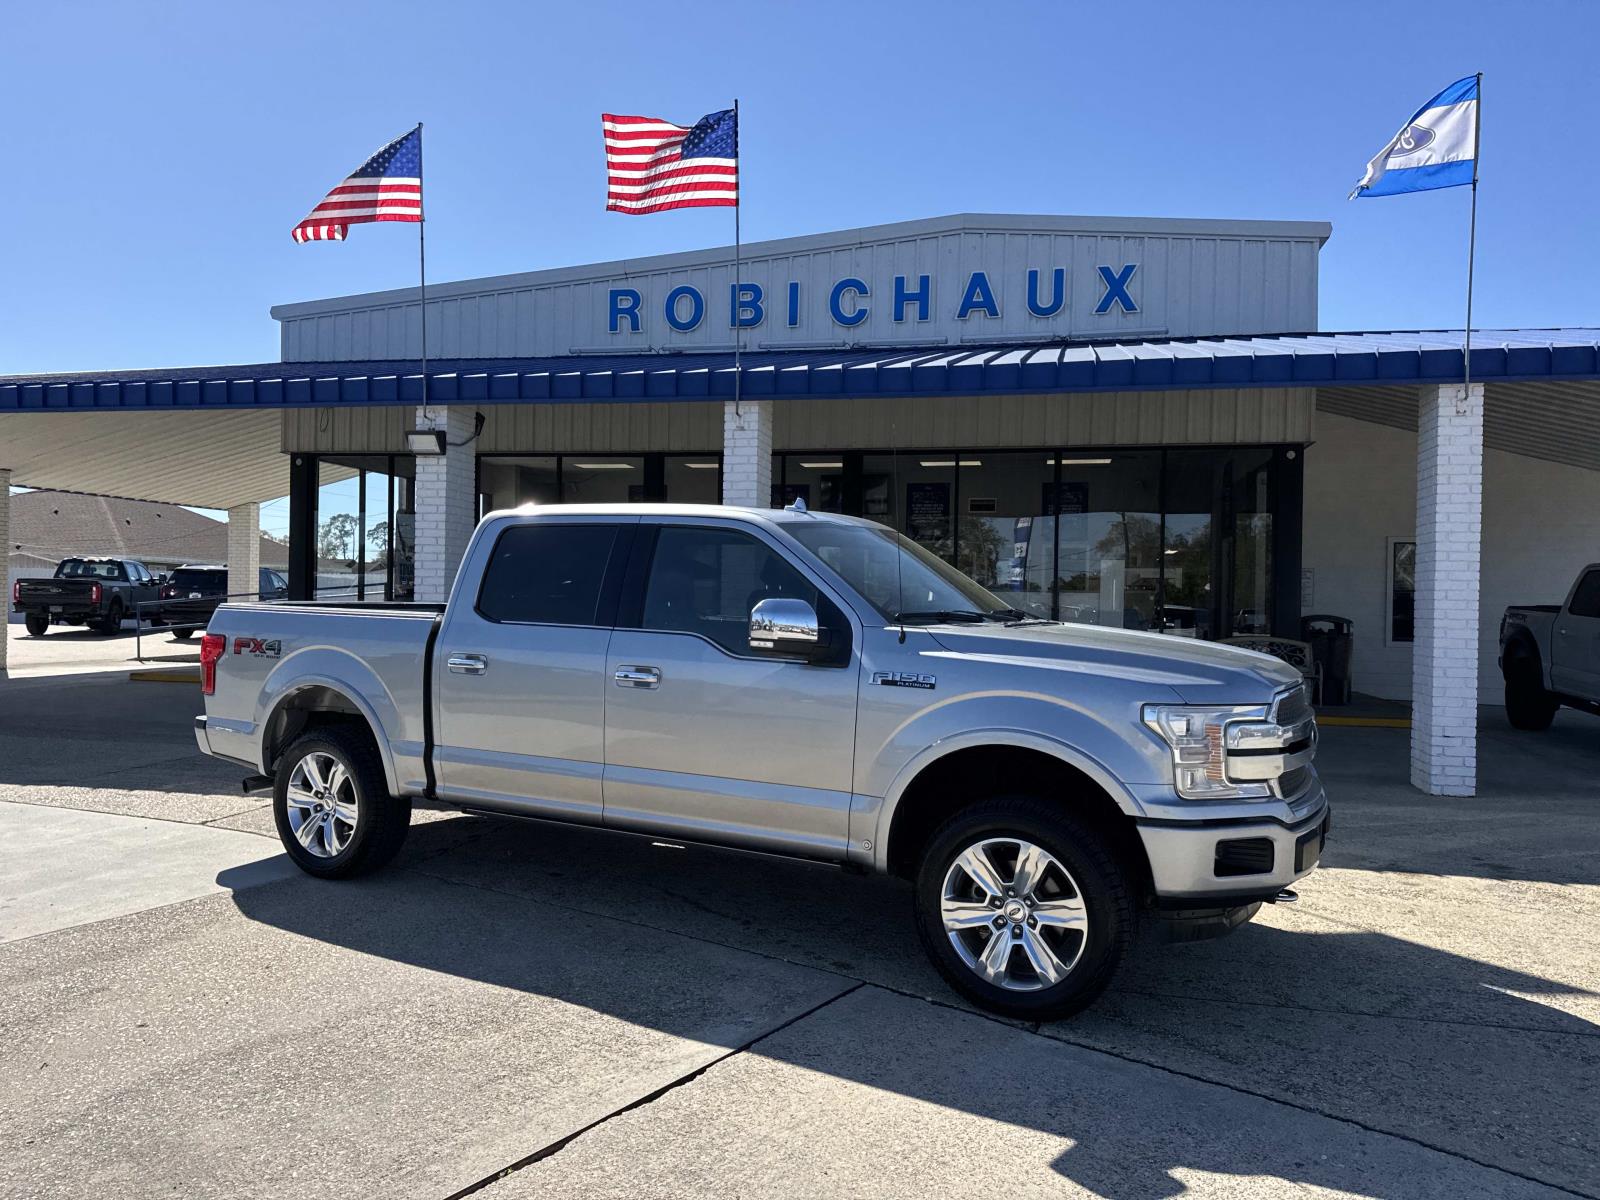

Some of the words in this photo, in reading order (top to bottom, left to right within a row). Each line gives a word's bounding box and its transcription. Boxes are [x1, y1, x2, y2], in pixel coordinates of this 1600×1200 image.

[608, 263, 1140, 334] ROBICHAUX
[234, 637, 281, 655] FX4
[896, 681, 931, 689] PLATINUM
